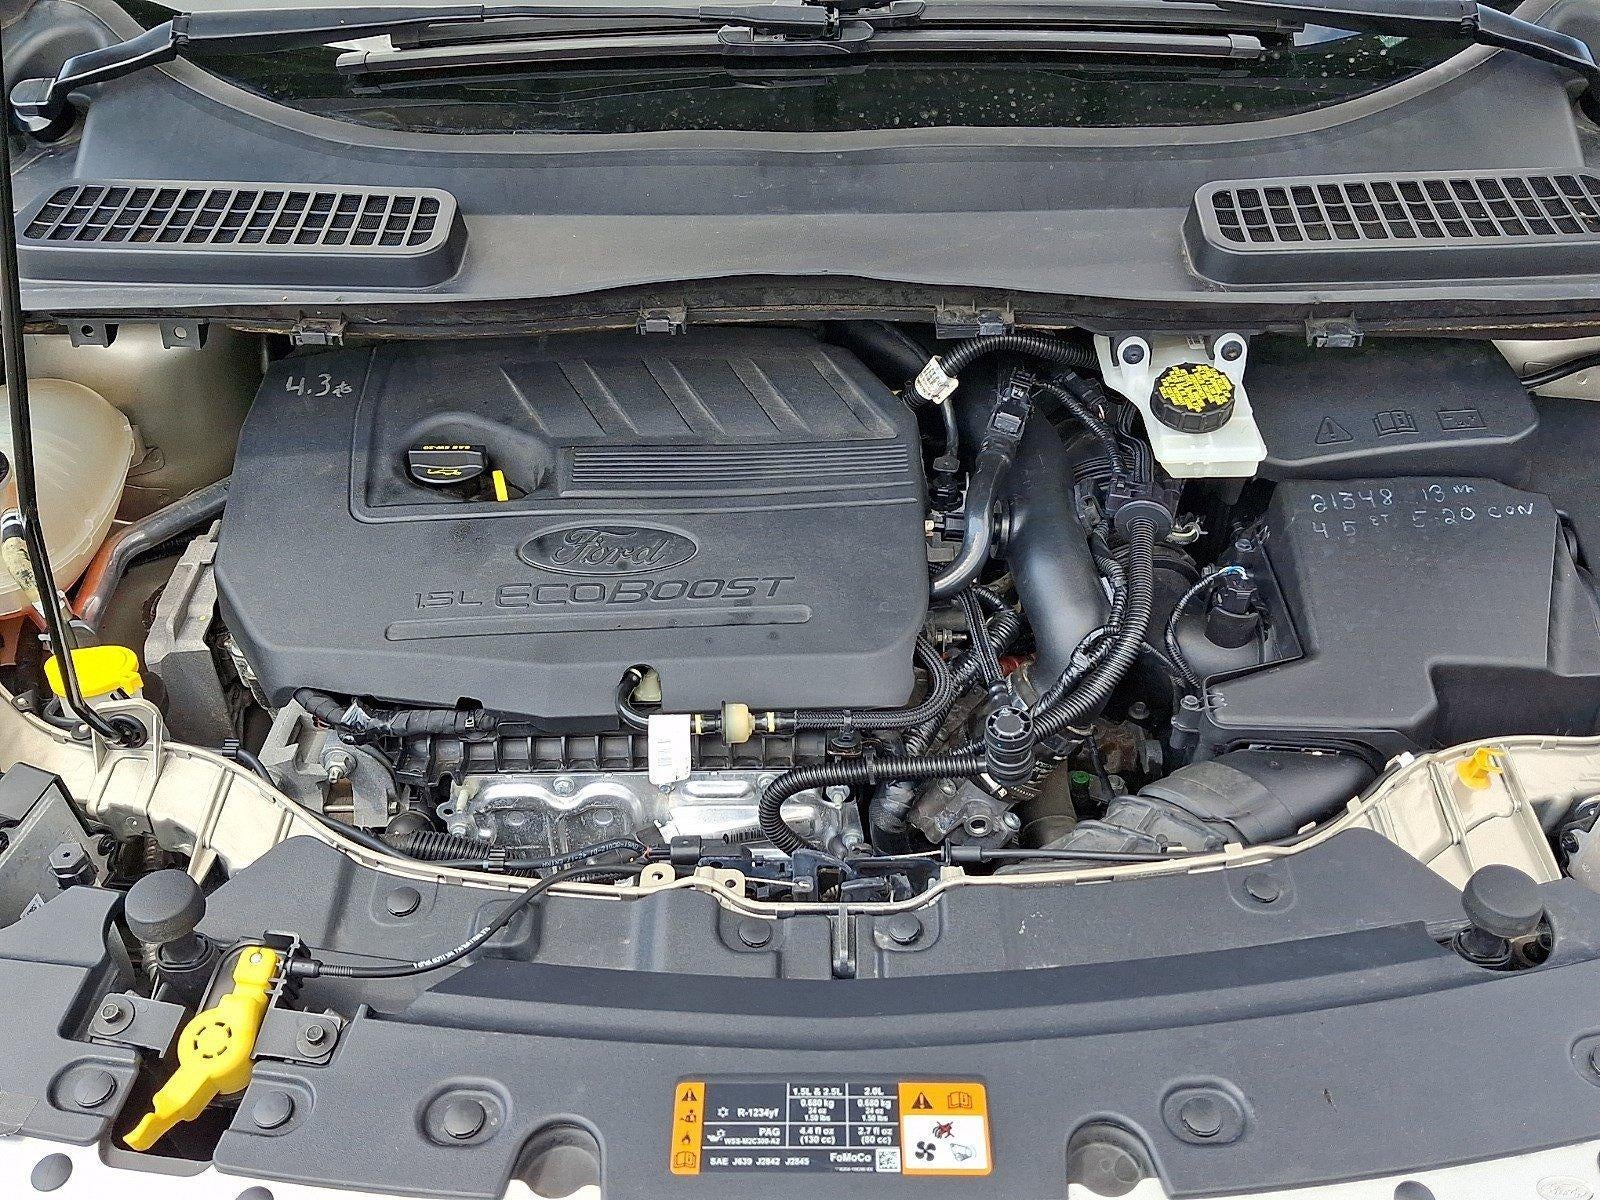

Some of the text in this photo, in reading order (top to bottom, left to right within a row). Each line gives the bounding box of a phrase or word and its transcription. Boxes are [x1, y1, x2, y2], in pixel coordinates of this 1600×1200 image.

[550, 528, 667, 566] Ford
[793, 1087, 843, 1096] 1.5L & 2.5L
[863, 1086, 885, 1096] 2.0L
[823, 1098, 835, 1109] kg
[880, 1098, 892, 1109] kg
[737, 1107, 779, 1119] R-1234yf
[758, 1127, 781, 1137] PAG
[799, 1126, 813, 1135] 4.4
[814, 1126, 822, 1135] fl
[872, 1126, 880, 1135] fl
[799, 1136, 836, 1145] (130 cc)
[876, 1136, 892, 1145] cc)
[709, 1157, 729, 1166] SAE
[731, 1157, 753, 1166] J639
[829, 1152, 872, 1163] FoMoCo
